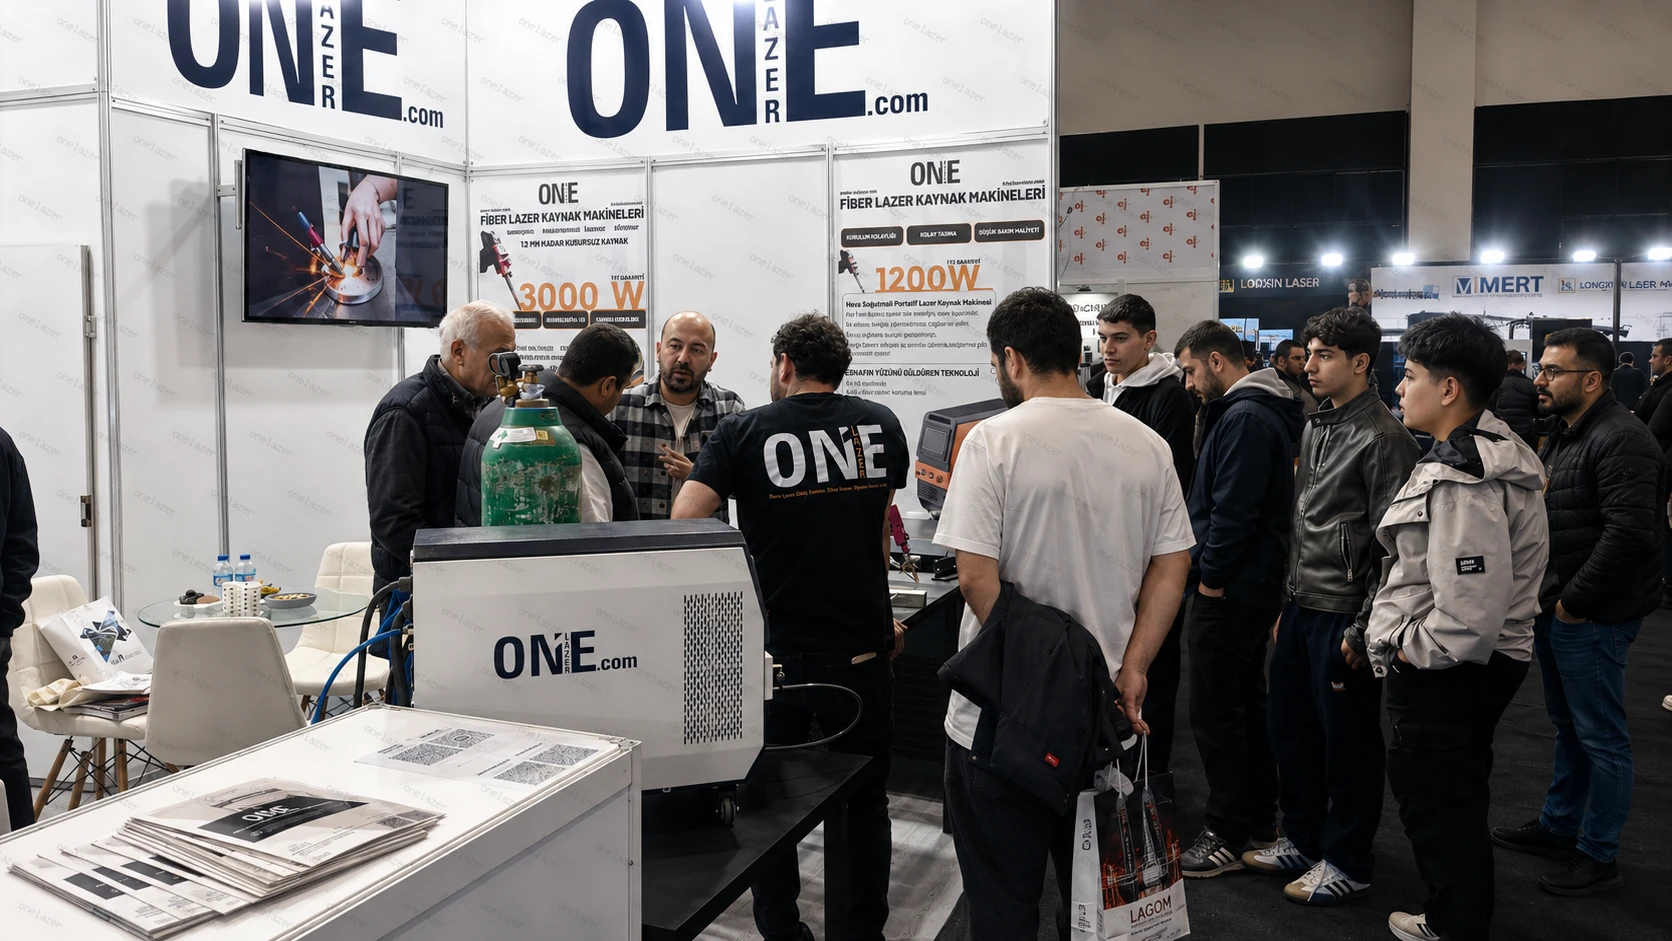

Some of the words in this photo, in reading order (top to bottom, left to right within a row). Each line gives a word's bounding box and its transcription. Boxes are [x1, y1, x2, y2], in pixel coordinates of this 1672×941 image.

[167, 0, 402, 121] ONE
[403, 105, 444, 129] .com
[319, 3, 336, 110] AZER
[566, 0, 866, 139] ONE
[867, 92, 929, 117] .com
[763, 0, 781, 124] AZER
[910, 159, 961, 187] ONE
[538, 181, 579, 206] ONE
[840, 194, 873, 210] FİBER
[875, 195, 914, 209] LAZER
[915, 192, 967, 206] KAYNAK
[969, 185, 1046, 205] MAKİNELERİ
[480, 212, 507, 226] FİBER
[509, 213, 540, 224] LAZER
[541, 210, 582, 223] KAYNAK
[583, 205, 645, 221] MAKİNELERİ
[875, 264, 981, 292] 1200W
[1285, 277, 1320, 288] LASER
[519, 282, 599, 311] 3000
[610, 280, 645, 310] W
[763, 424, 887, 488] ONE
[493, 630, 597, 680] ONE
[597, 655, 638, 672] .com
[1129, 895, 1172, 924] LAGOM
